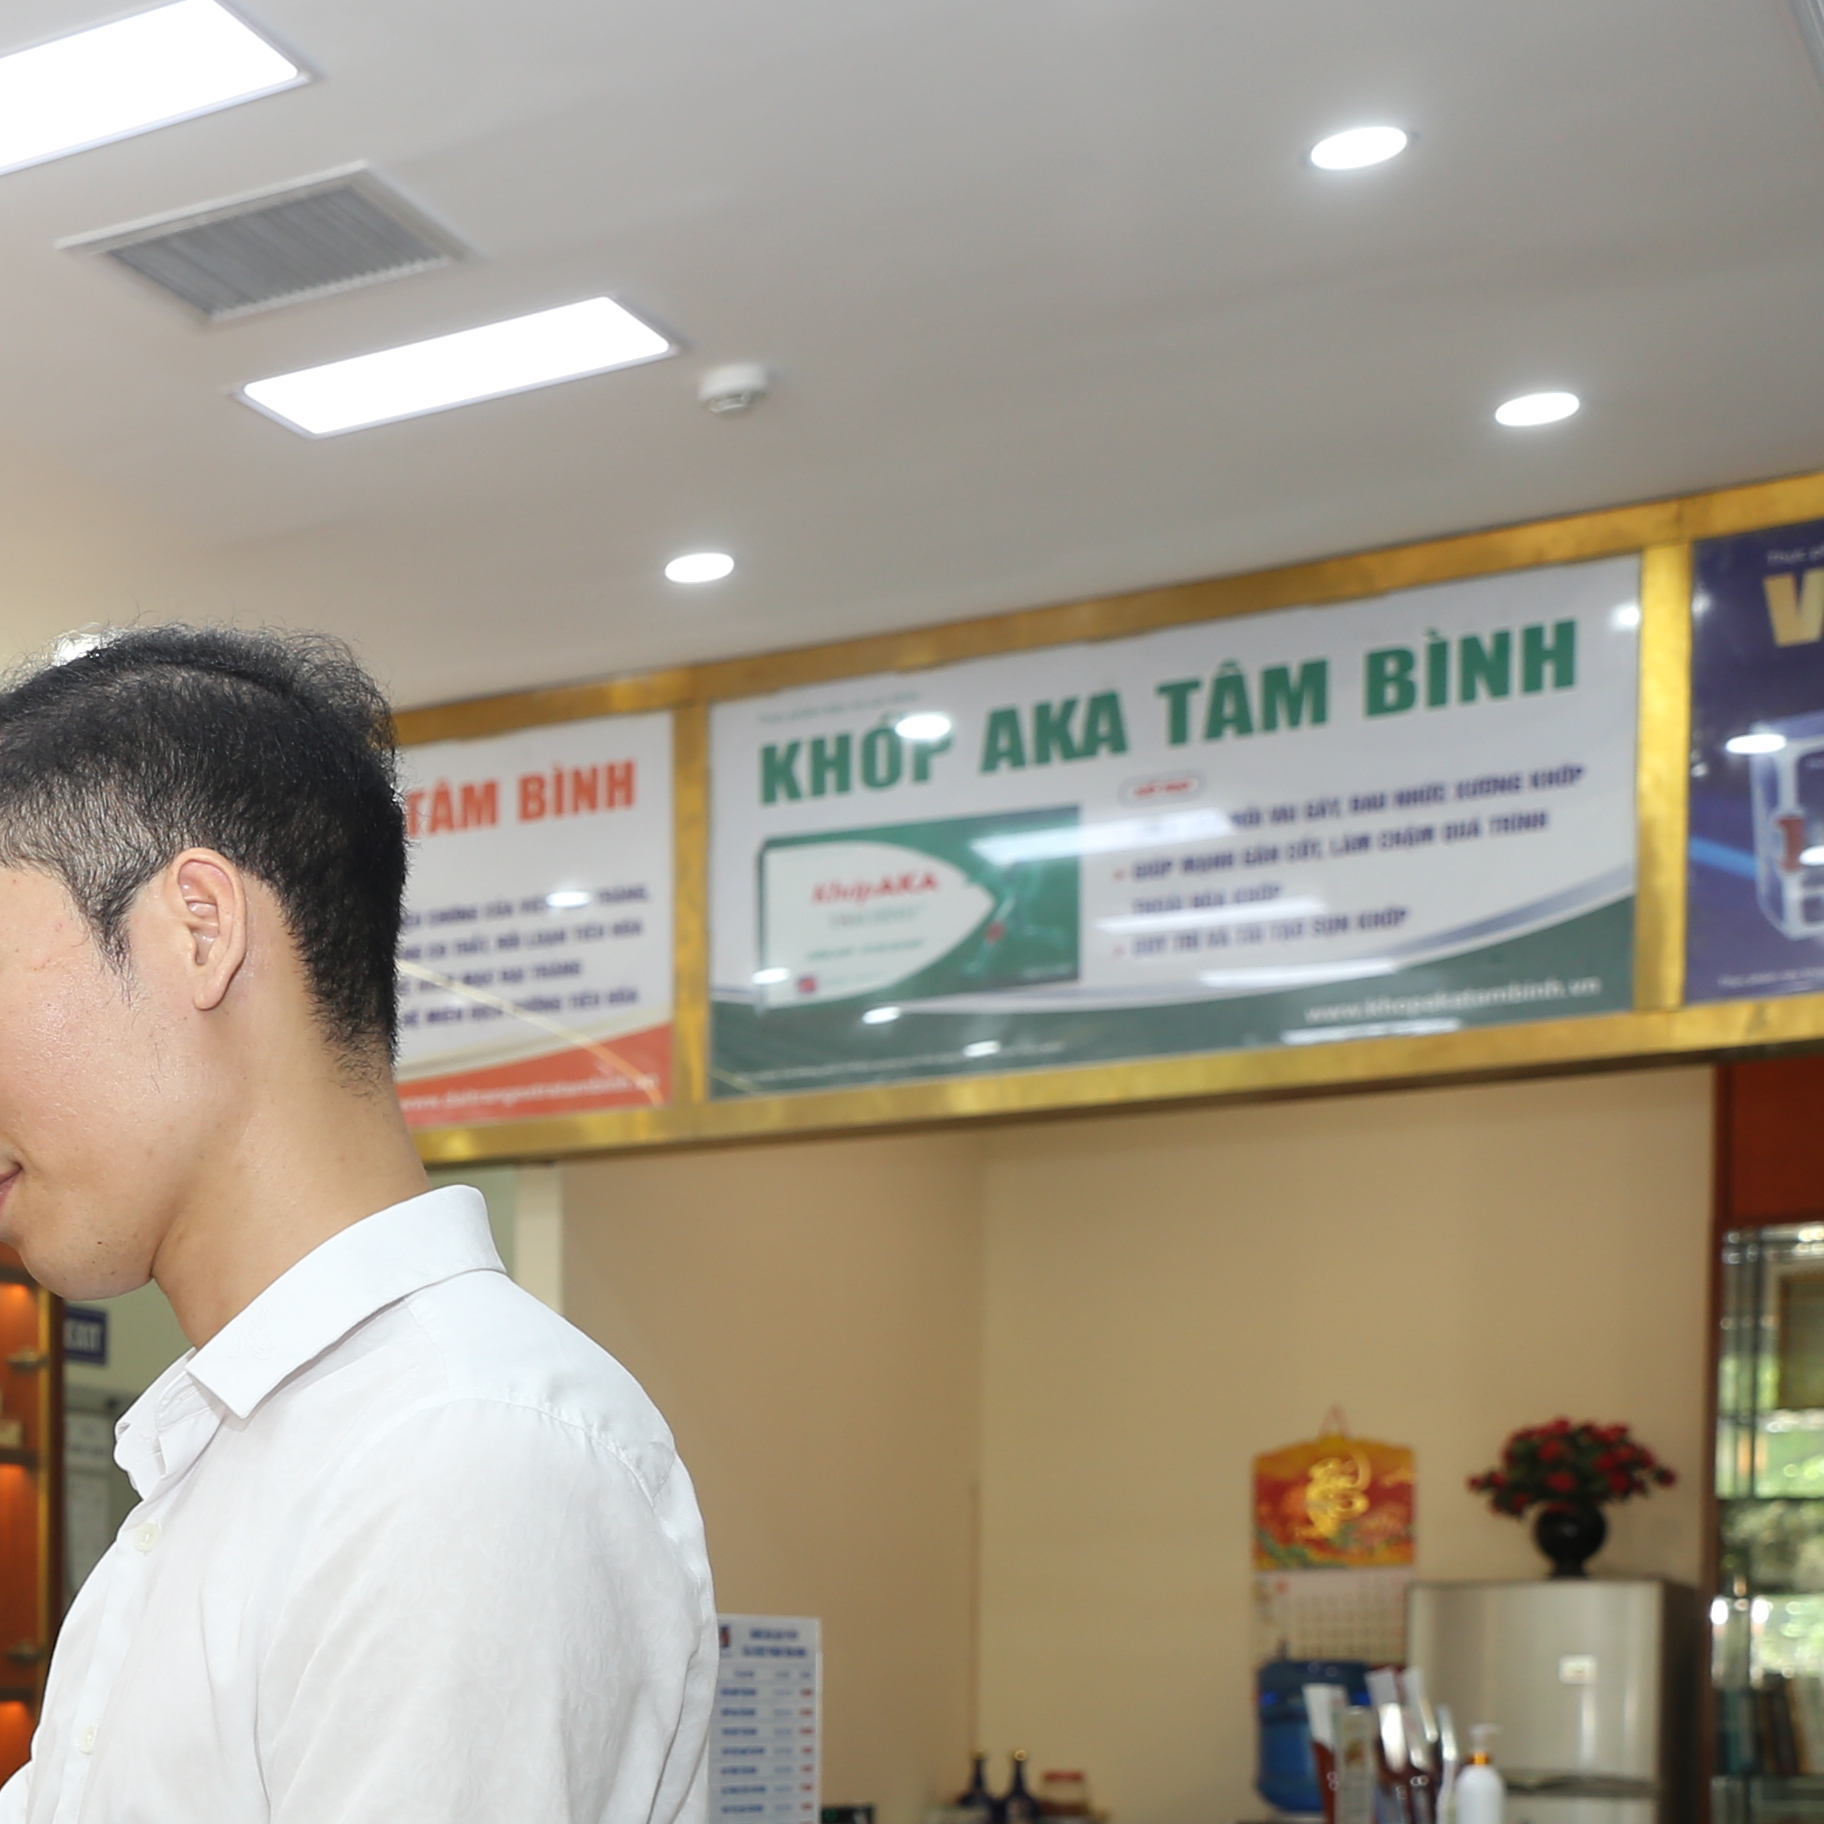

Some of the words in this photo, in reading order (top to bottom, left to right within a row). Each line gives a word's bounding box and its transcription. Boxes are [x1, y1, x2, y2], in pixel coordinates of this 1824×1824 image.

[761, 712, 955, 805] KHỚP
[981, 688, 1128, 774] AKA
[1158, 657, 1331, 747] TÂM
[1365, 616, 1578, 720] BÌNH
[403, 777, 500, 840] TÂM
[518, 760, 636, 823] BÌNH
